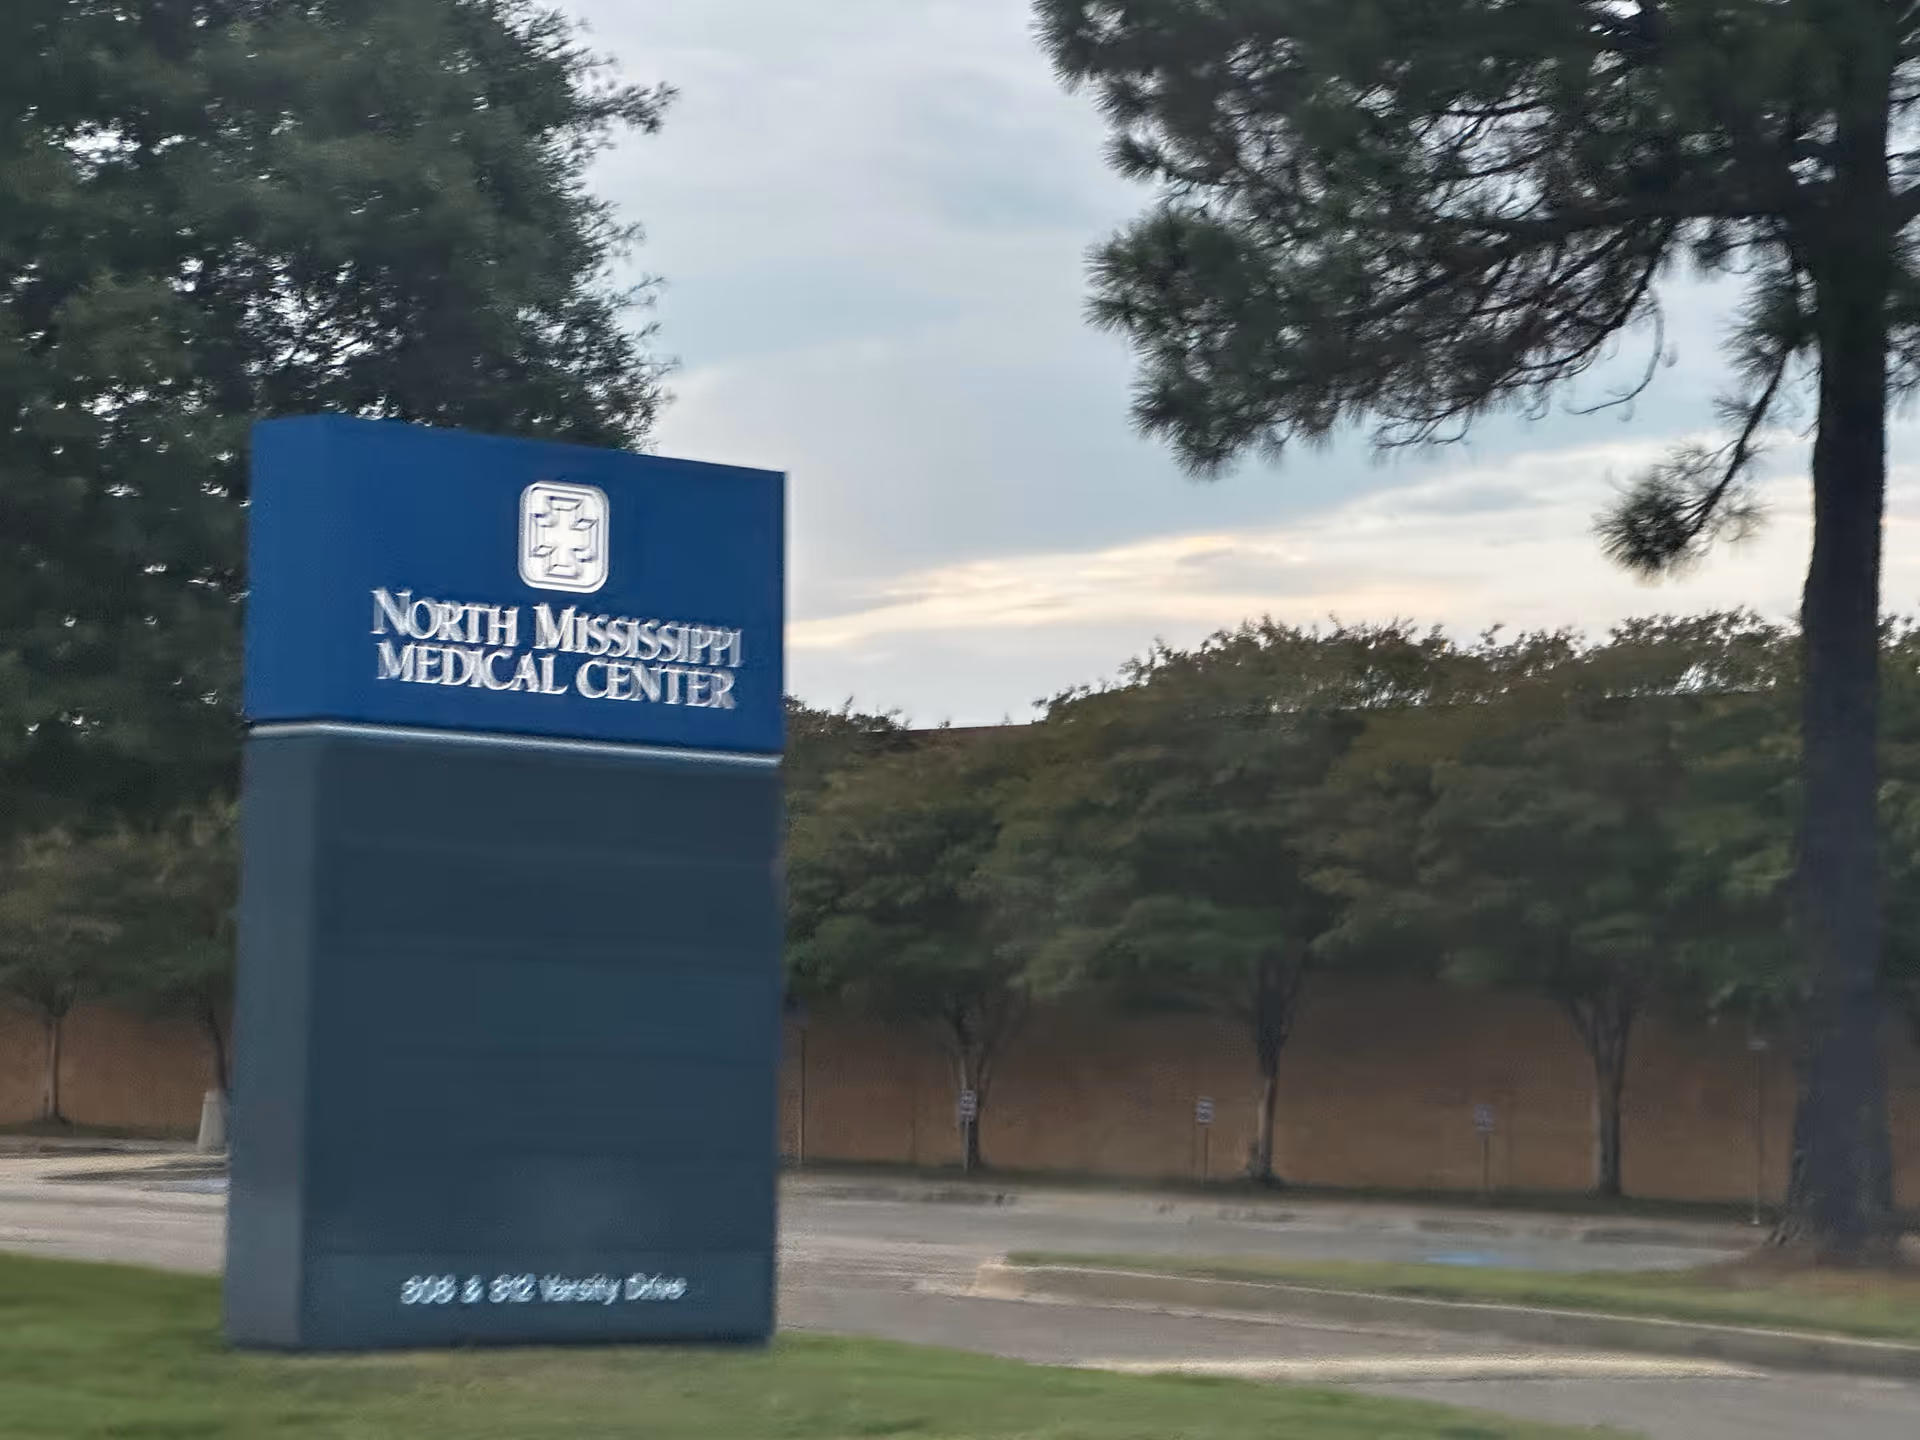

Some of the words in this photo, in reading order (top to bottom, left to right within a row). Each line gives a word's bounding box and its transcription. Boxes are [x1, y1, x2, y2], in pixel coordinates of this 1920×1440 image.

[370, 587, 520, 647] NORTH
[532, 602, 744, 668] MISSISSIPPI
[376, 639, 569, 696] MEDICAL
[576, 656, 736, 710] CENTER
[538, 1273, 623, 1306] Varsity
[624, 1272, 689, 1302] Drive
